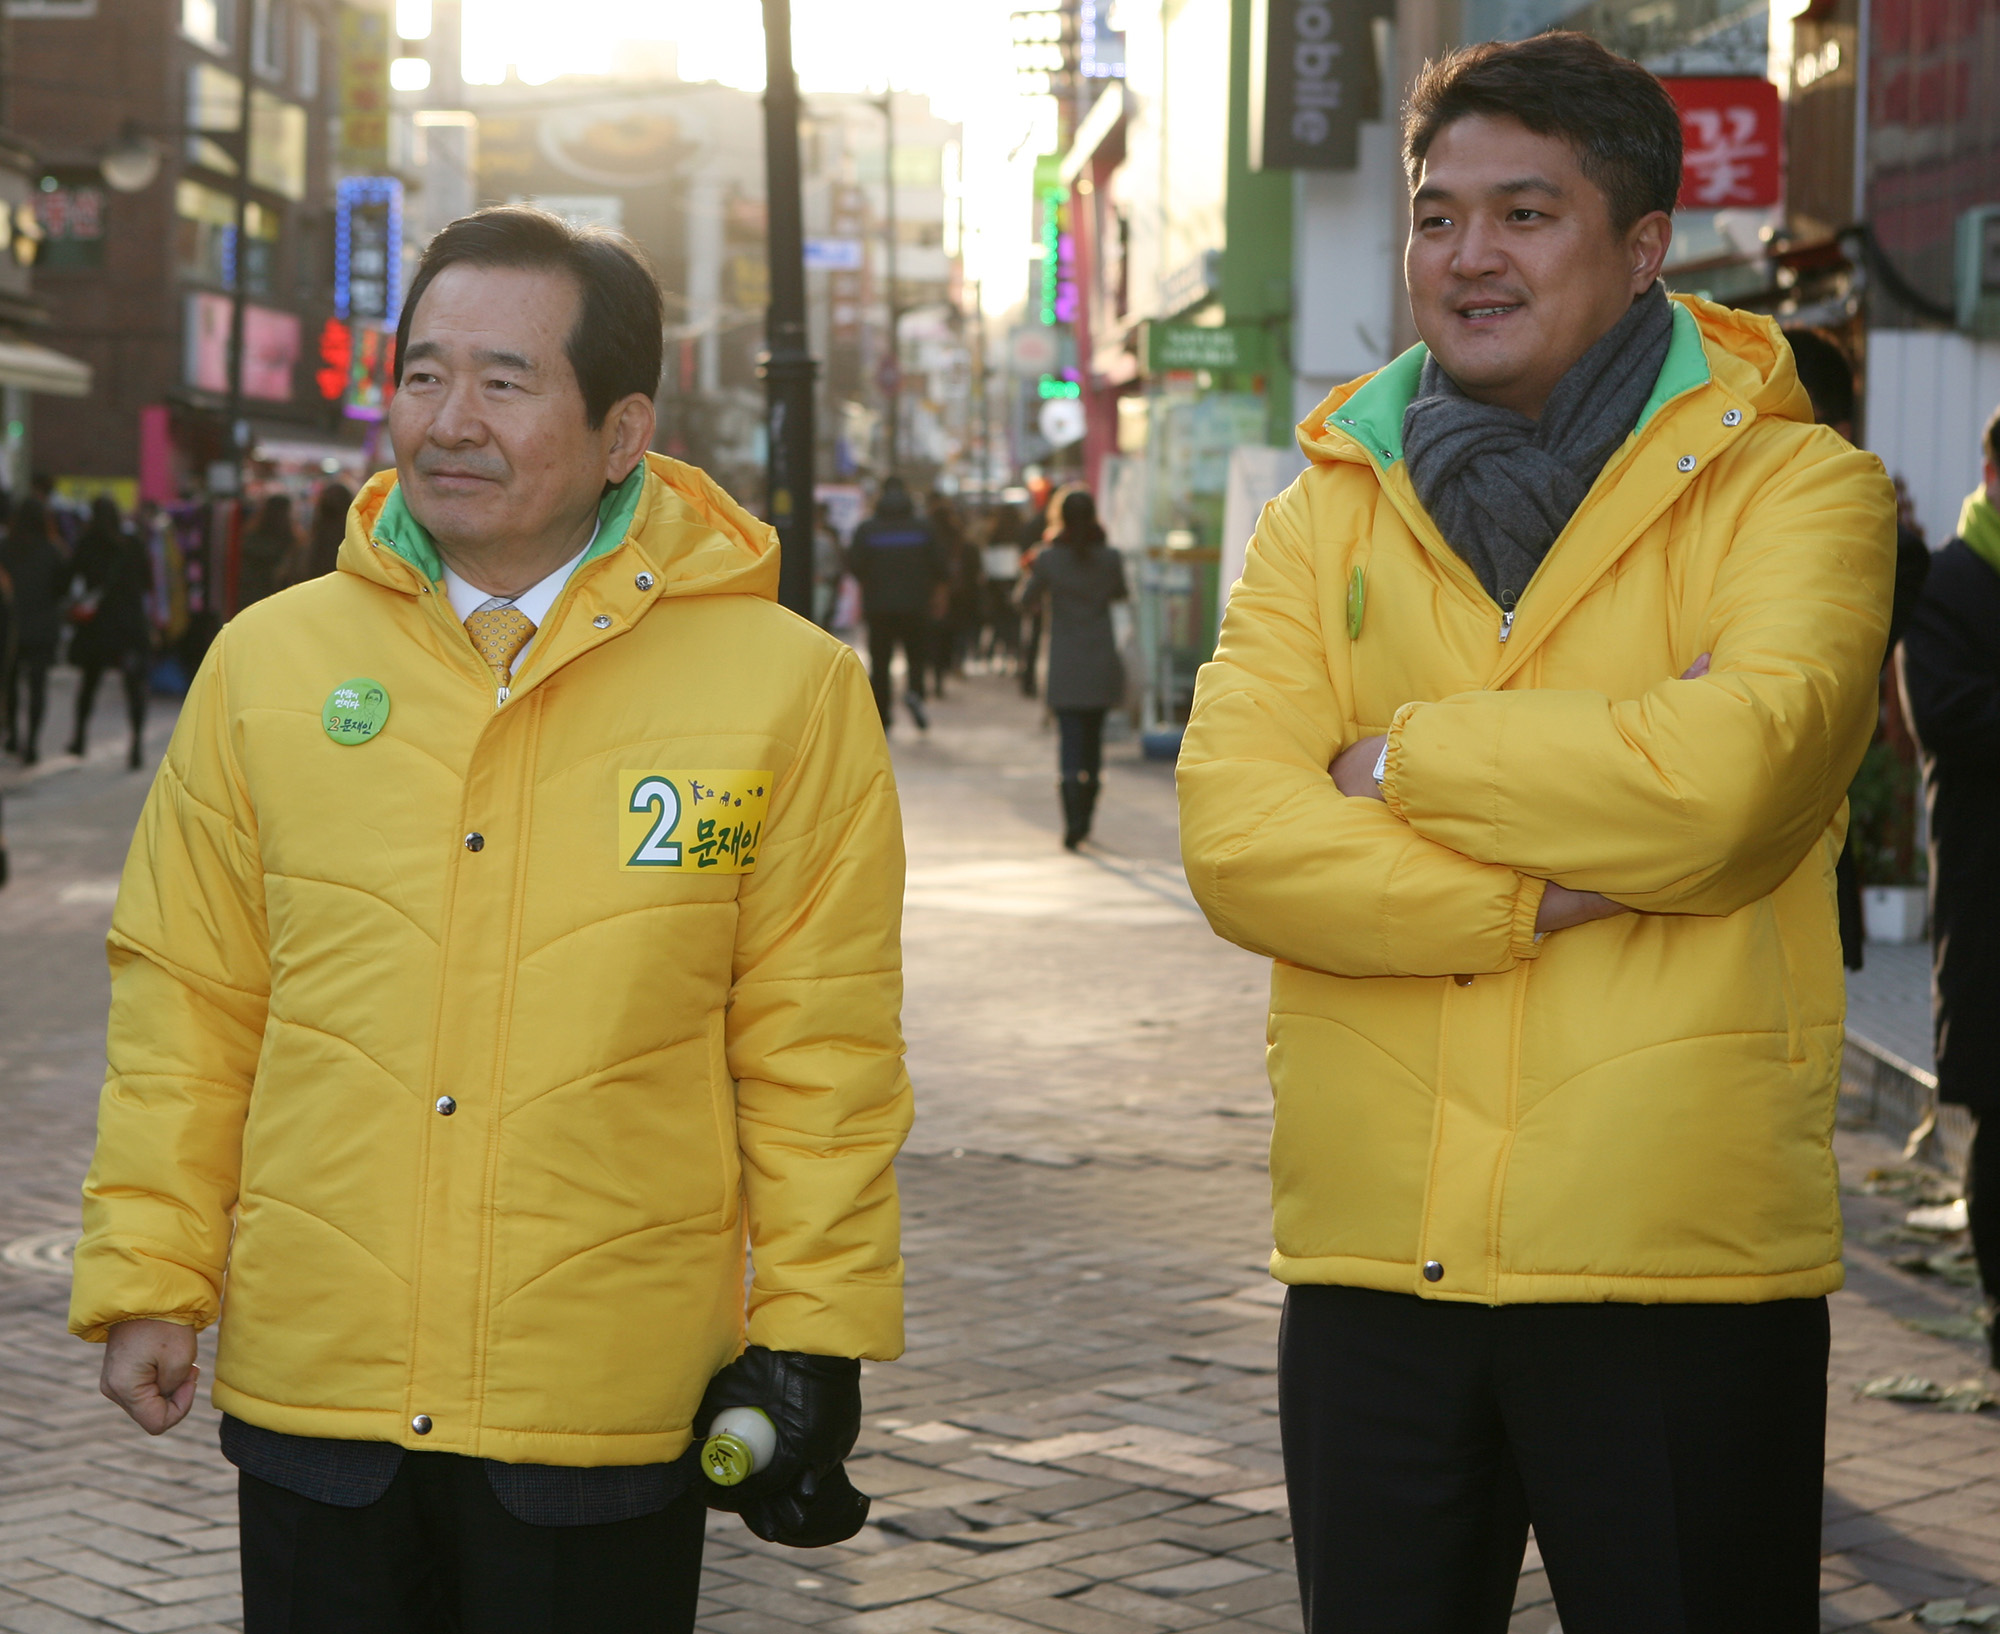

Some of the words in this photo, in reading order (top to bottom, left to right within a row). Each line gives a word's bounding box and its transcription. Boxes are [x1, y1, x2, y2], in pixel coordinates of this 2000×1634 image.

[1293, 0, 1342, 145] obile
[1682, 106, 1768, 203] 꽃
[327, 716, 340, 731] 2
[340, 719, 373, 735] 문재인
[626, 775, 682, 866] 2
[688, 818, 762, 868] 문재인
